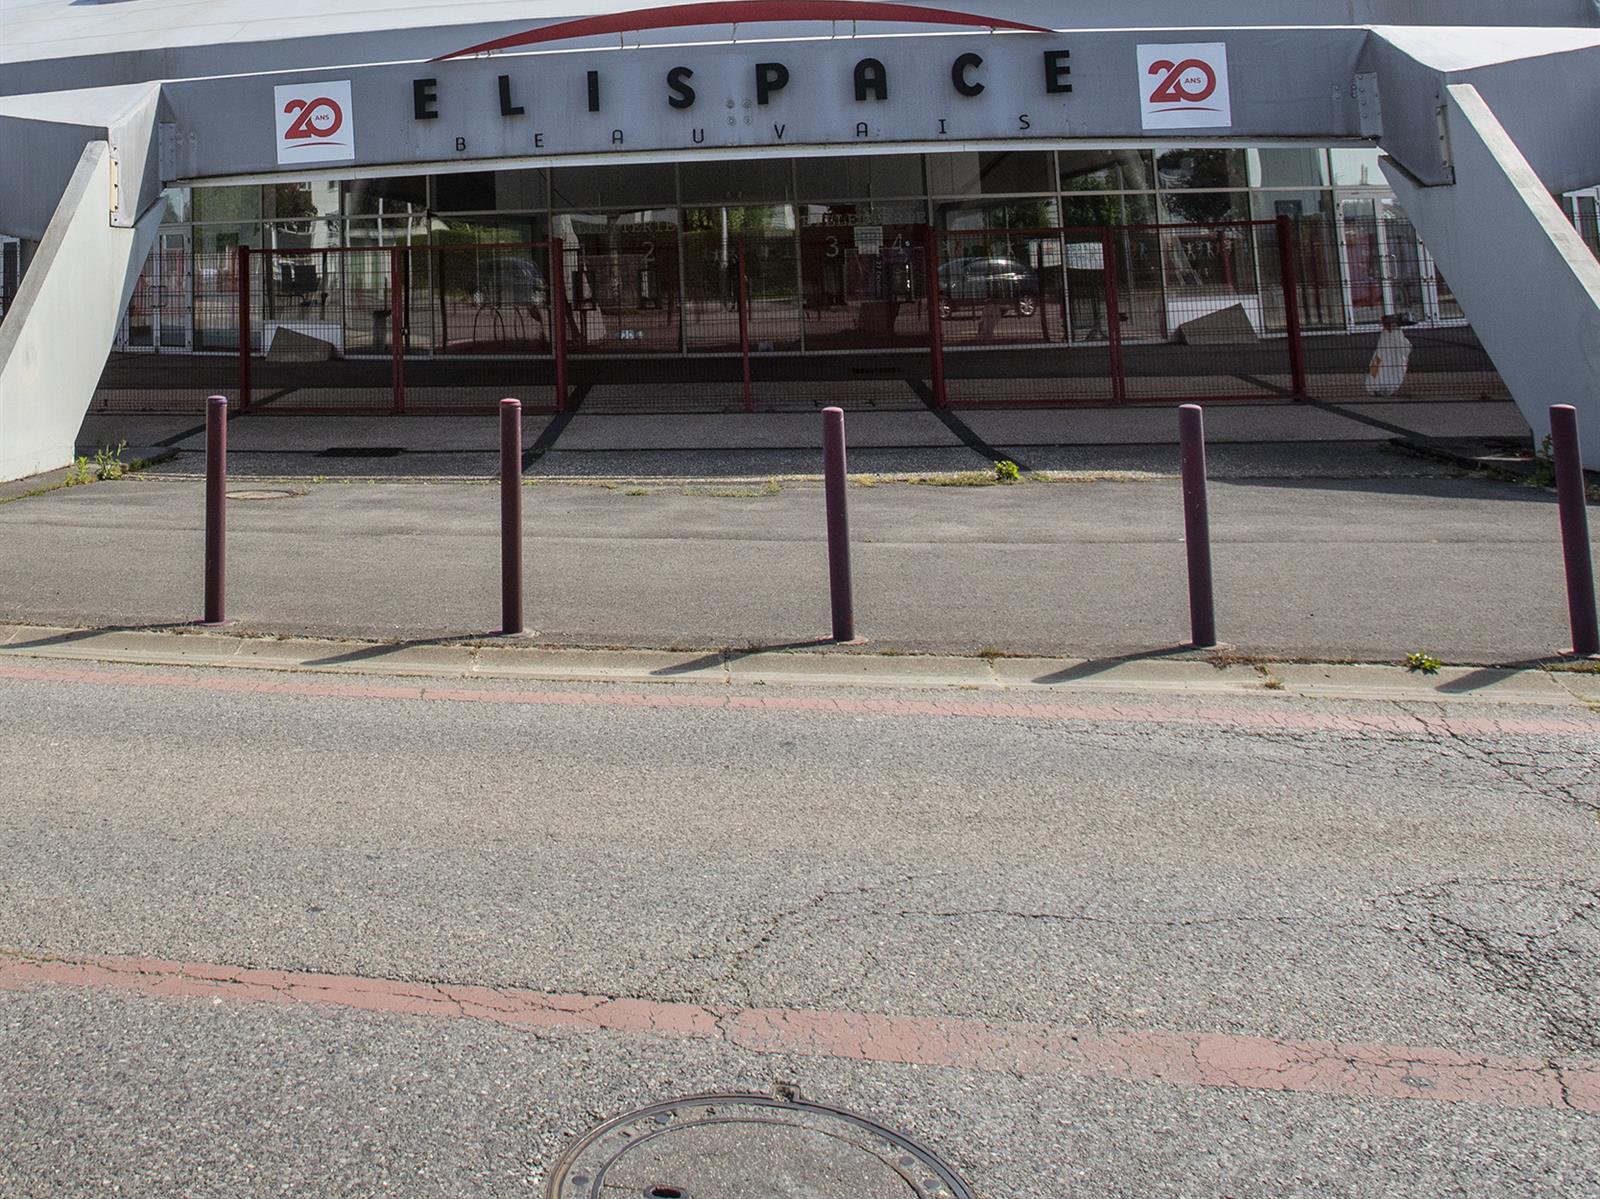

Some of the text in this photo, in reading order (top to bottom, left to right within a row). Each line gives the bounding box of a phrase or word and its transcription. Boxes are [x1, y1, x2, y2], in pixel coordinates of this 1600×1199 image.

[413, 50, 1072, 120] ELISPACE
[1148, 58, 1217, 103] 20 ANS
[284, 97, 343, 140] 20
[455, 114, 1031, 151] BEAUVAIS
[800, 211, 927, 227] BLLEERIE
[641, 241, 655, 262] 2
[825, 235, 840, 258] 3
